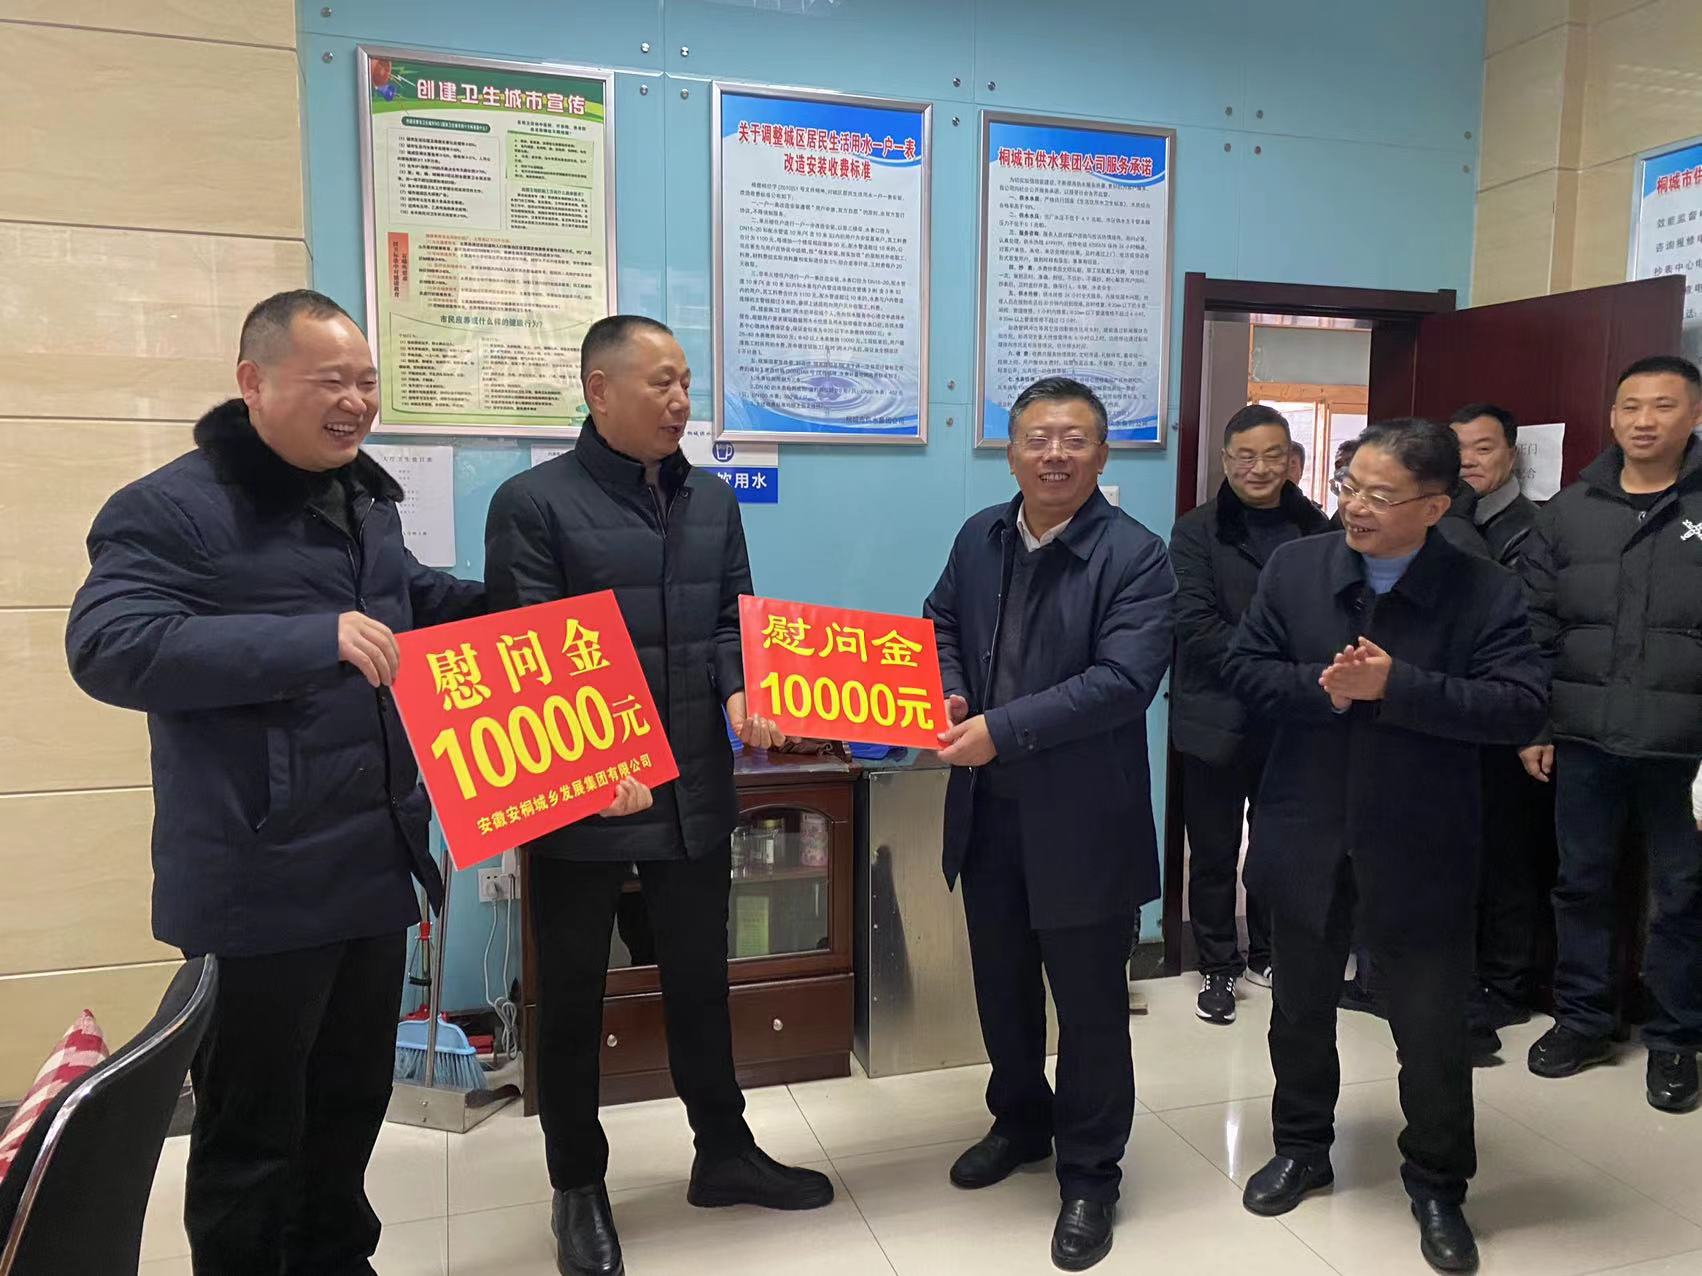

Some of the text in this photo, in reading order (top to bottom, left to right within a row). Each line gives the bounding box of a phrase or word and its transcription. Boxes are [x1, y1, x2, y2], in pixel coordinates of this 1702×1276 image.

[416, 79, 586, 115] 创建卫生城市宣传
[738, 122, 916, 160] 关于调整城区居民生活用水一户一表
[784, 153, 872, 181] 改造安装收费标准
[999, 147, 1154, 176] 桐城市供水集团公司服务承诺
[425, 618, 610, 711] 慰问金
[761, 614, 923, 668] 慰问金
[759, 672, 935, 730] 10000元
[430, 685, 651, 800] 10000元
[476, 754, 652, 836] 安徽安桐城乡发展集团有限公司
